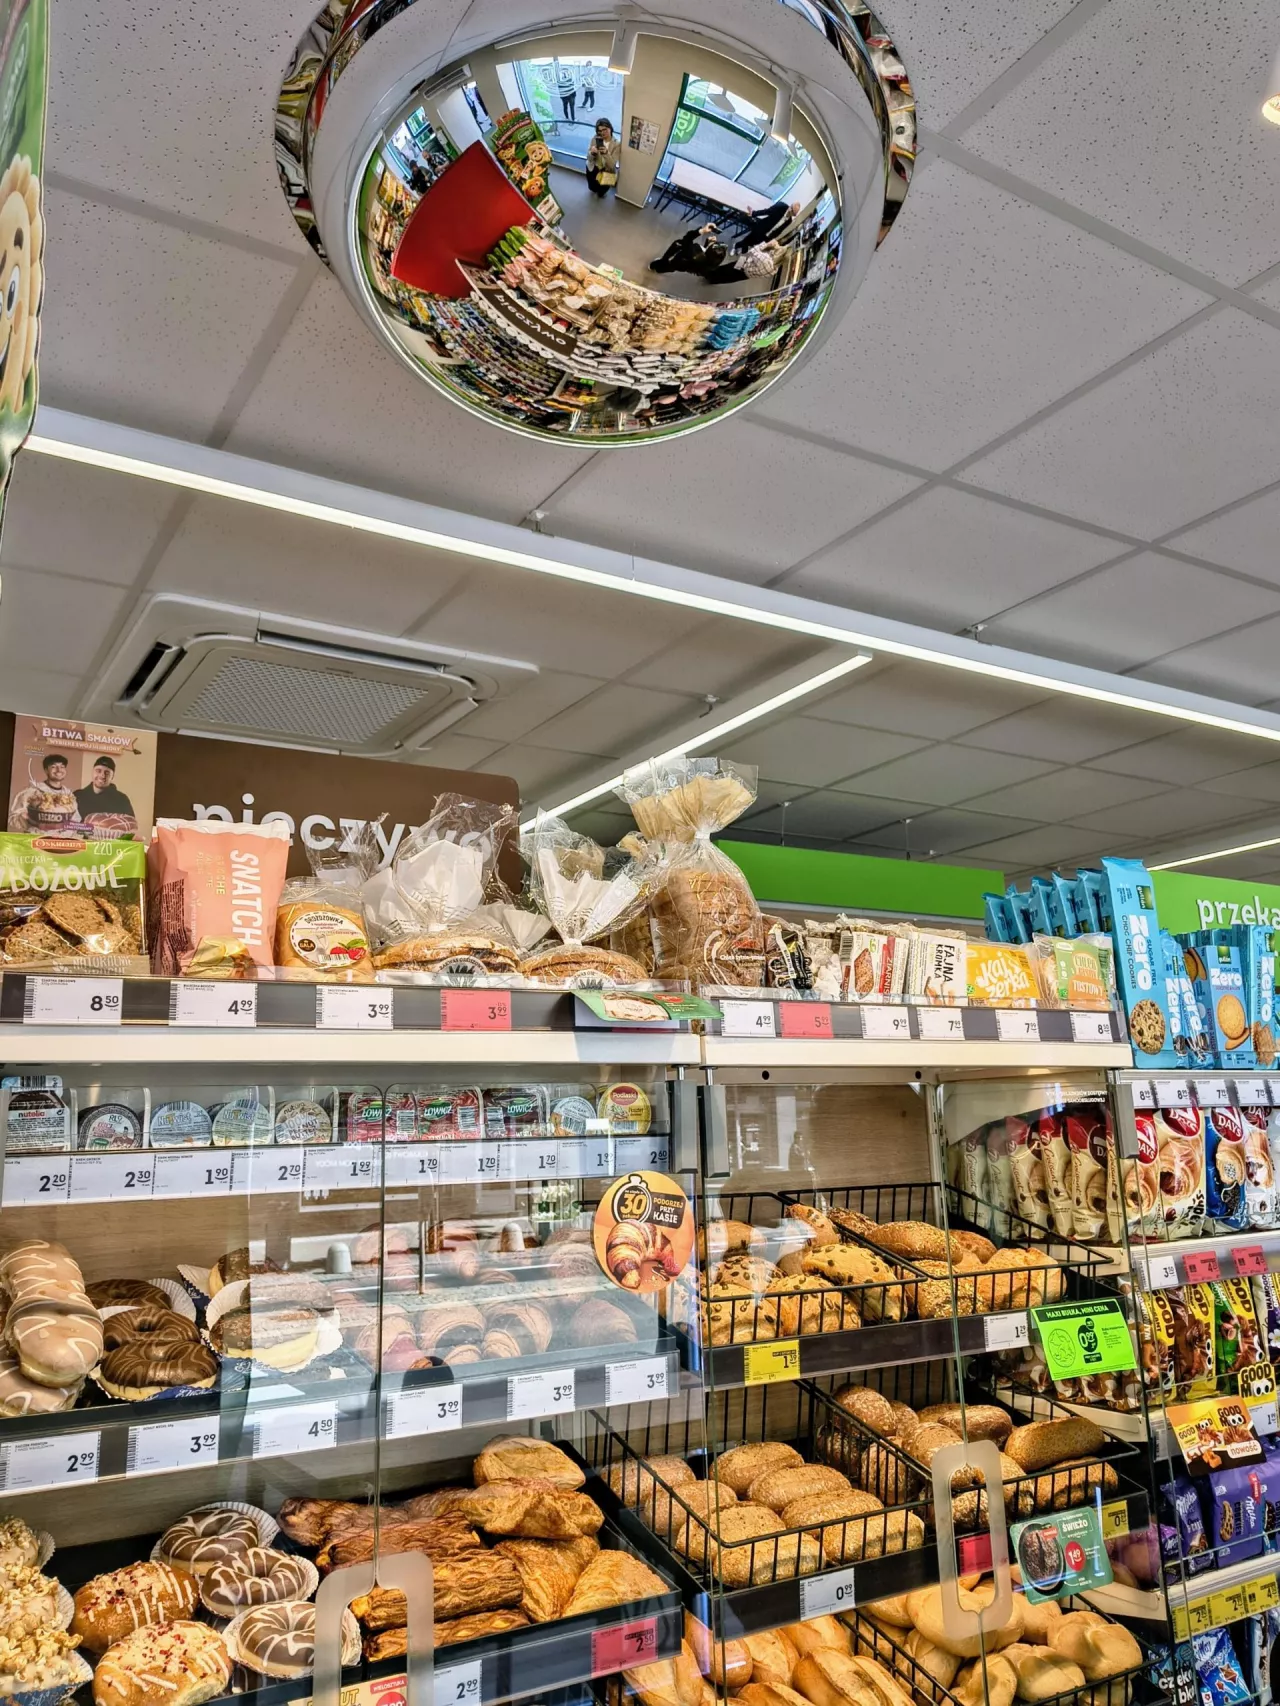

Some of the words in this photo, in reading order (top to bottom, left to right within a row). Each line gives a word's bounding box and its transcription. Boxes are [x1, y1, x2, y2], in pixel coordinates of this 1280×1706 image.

[42, 727, 83, 740] BITWA
[87, 733, 131, 746] SMAKÓW
[93, 842, 112, 856] 220
[230, 849, 263, 946] SNATCH
[1121, 915, 1130, 936] CHOC
[1125, 937, 1133, 954] CHIP
[934, 944, 944, 979] KROMKA
[943, 945, 955, 982] FAJNA
[1128, 956, 1137, 989] COOKIES
[612, 1091, 637, 1100] Podlaski
[361, 1106, 392, 1118] ŁOWIZ
[423, 1104, 452, 1117] ŁOWICZ
[508, 1102, 534, 1114] ŁOWICZ
[1218, 1116, 1242, 1137] DAYS
[620, 1193, 647, 1214] 30
[653, 1197, 684, 1209] PODGRZEJ
[653, 1211, 679, 1224] KASIE
[1241, 1363, 1272, 1382] GOOD
[1217, 1405, 1242, 1418] GOOD
[1178, 1425, 1196, 1440] GOOD
[1245, 1496, 1257, 1529] Milka
[1062, 1518, 1089, 1533] ŚWIEŻO
